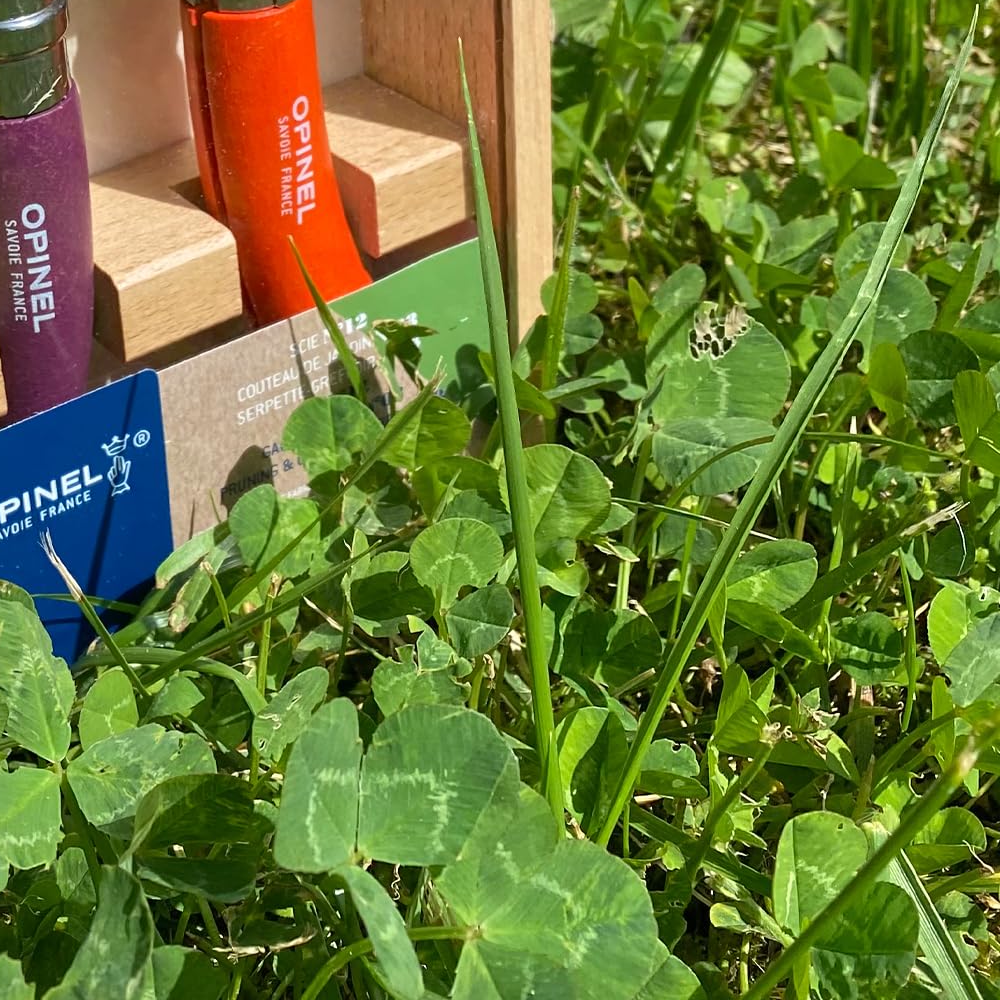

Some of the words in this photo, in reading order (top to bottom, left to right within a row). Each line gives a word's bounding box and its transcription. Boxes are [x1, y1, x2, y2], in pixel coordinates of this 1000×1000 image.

[278, 116, 292, 160] SAVOIE
[292, 95, 316, 225] OPINEL
[280, 167, 293, 217] FRANCE
[4, 220, 22, 265] SAVOIE
[21, 203, 56, 333] OPINEL
[10, 272, 28, 322] FRANCE
[289, 332, 320, 359] SCIE
[237, 367, 299, 402] COUTEAU
[303, 355, 321, 374] DE
[325, 337, 372, 367] JADIN
[237, 385, 310, 425] SERPETTE
[39, 489, 92, 521] FRANCE
